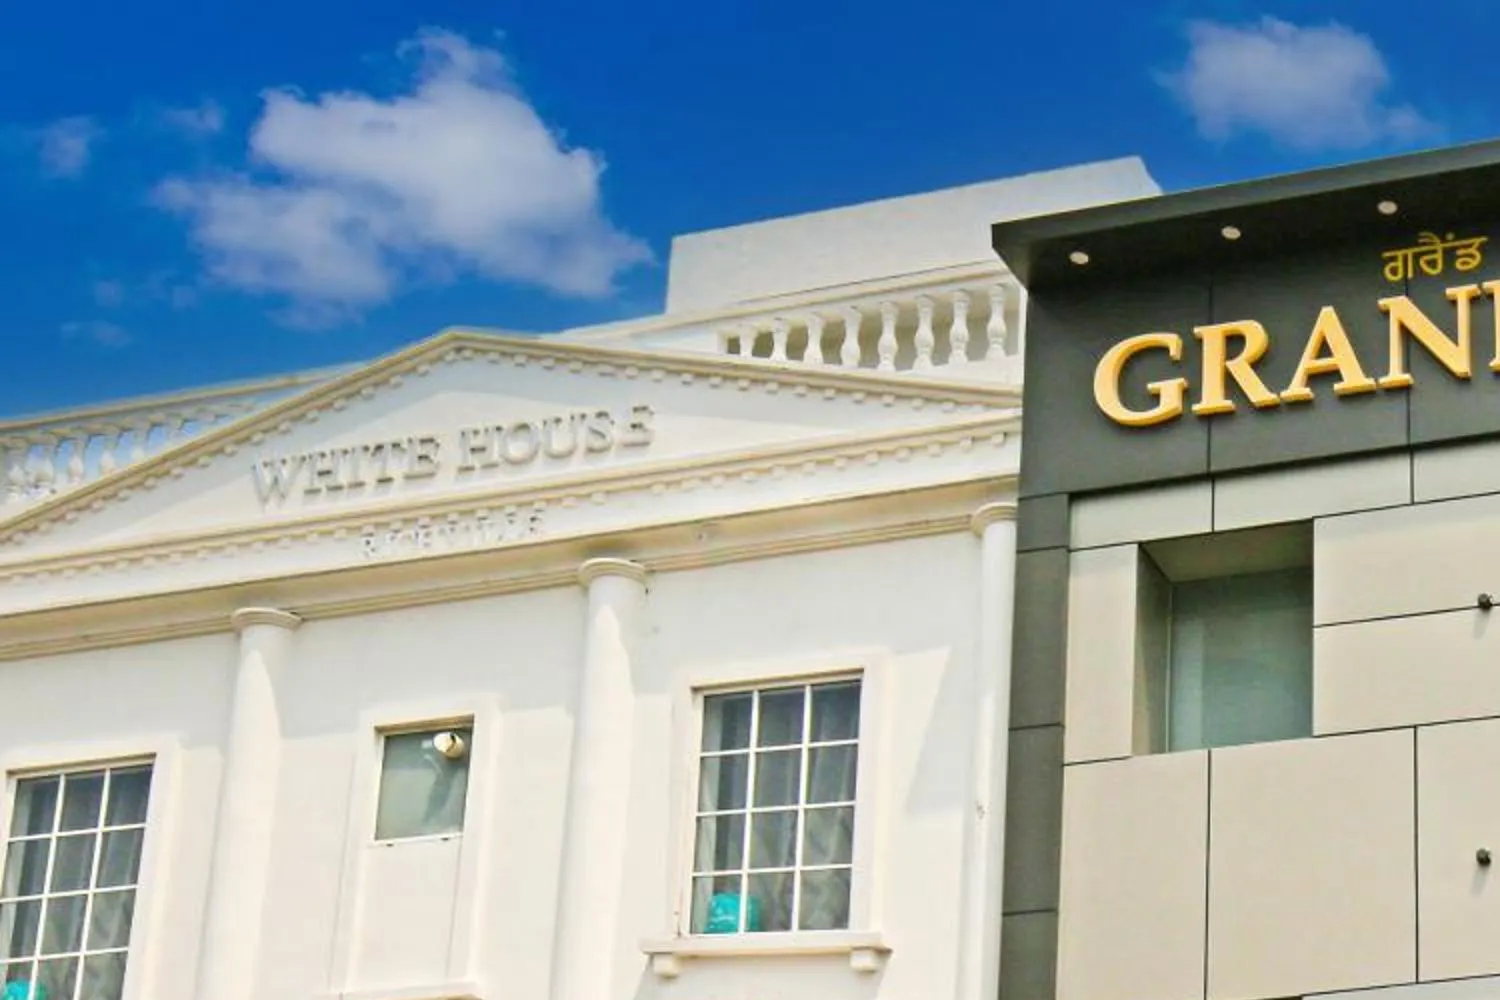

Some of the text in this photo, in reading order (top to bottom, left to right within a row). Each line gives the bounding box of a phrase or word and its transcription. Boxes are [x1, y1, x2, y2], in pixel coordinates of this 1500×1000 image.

[1382, 231, 1489, 281] ਗਰੈਂਡ
[251, 404, 655, 514] WHITE HOUSE
